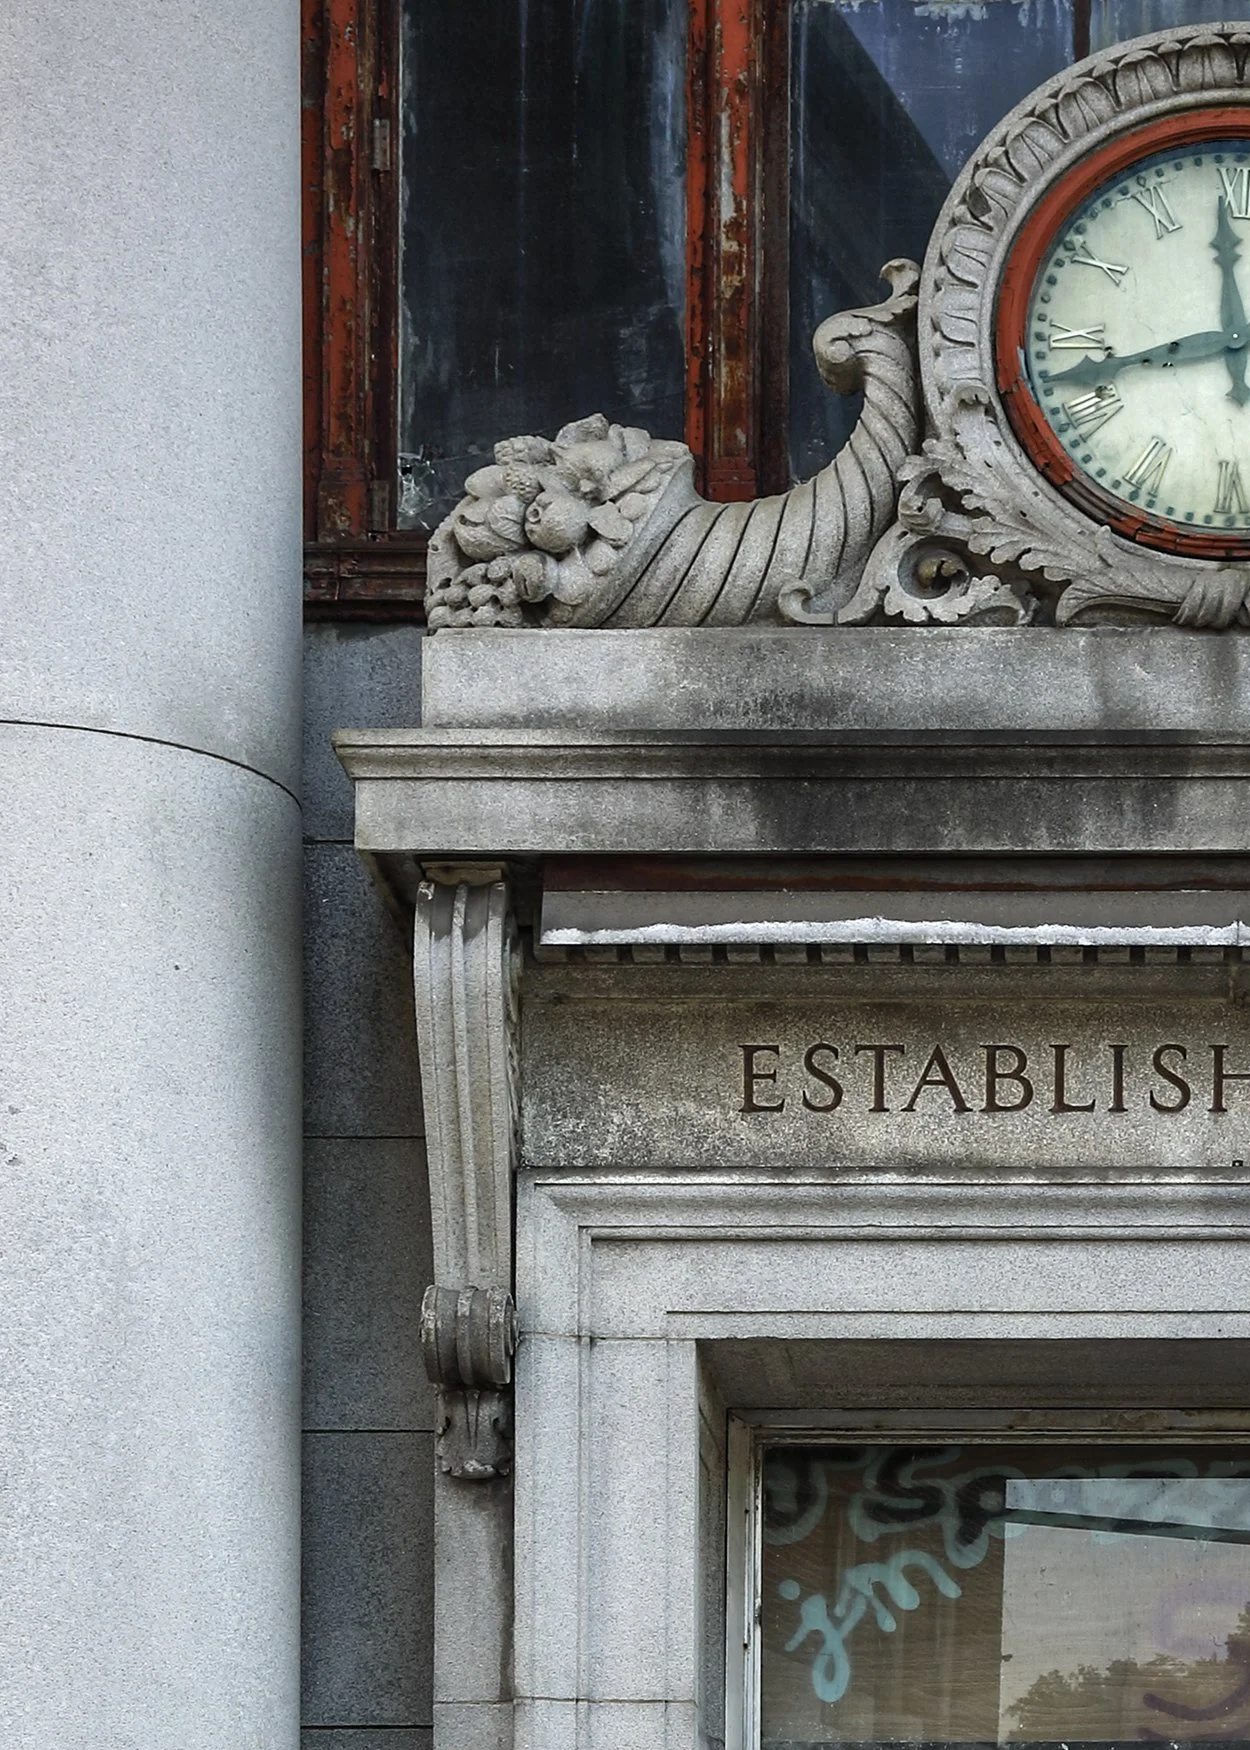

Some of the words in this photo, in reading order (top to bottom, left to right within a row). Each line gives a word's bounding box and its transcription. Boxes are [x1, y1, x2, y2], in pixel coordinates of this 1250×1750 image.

[1071, 241, 1130, 286] X
[1048, 318, 1106, 350] IX
[1122, 435, 1173, 498] VII
[1212, 459, 1250, 514] VI
